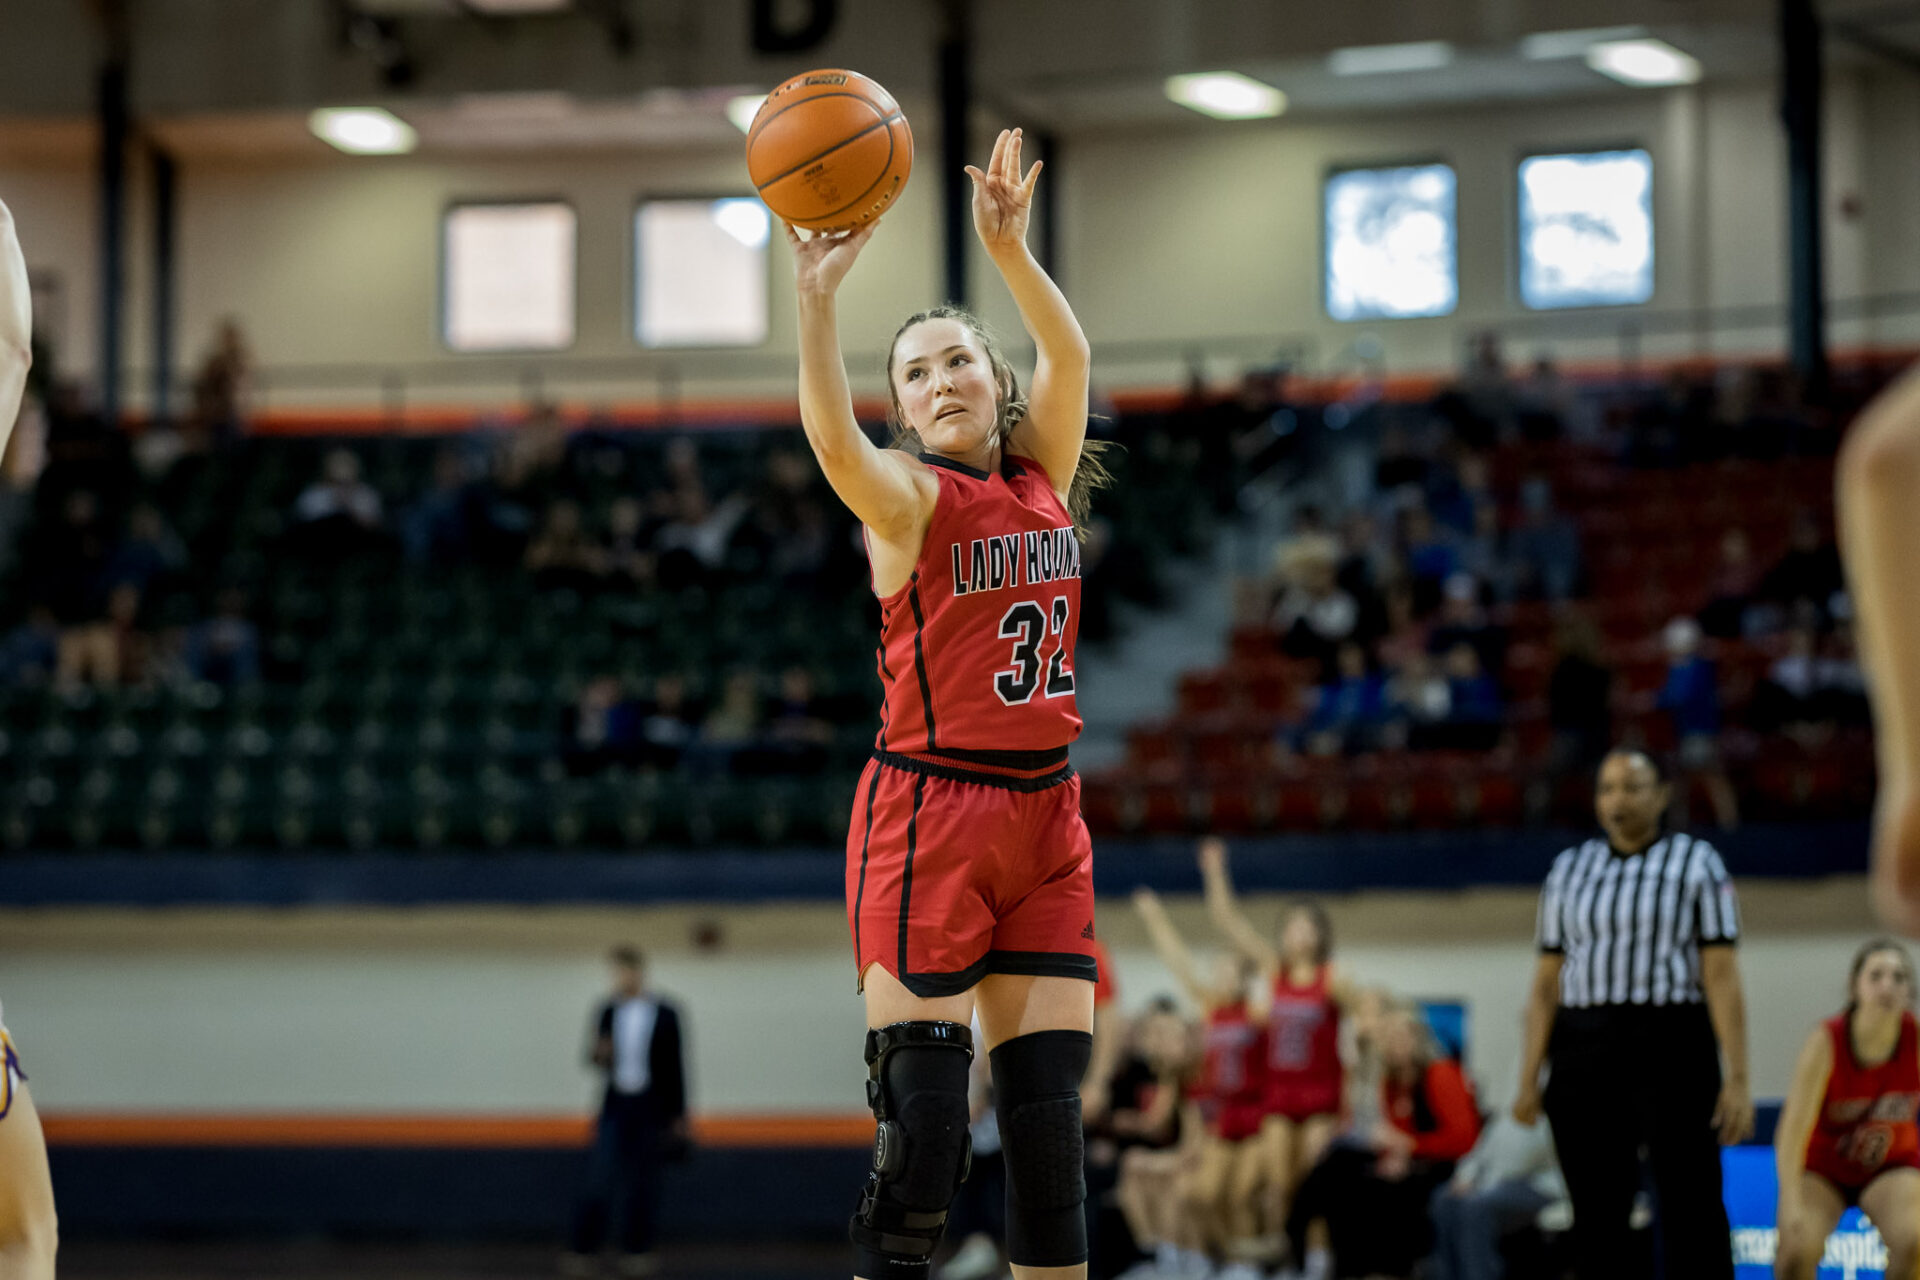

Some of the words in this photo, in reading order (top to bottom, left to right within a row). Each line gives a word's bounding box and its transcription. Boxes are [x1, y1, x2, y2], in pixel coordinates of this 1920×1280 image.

[951, 533, 1020, 597] LADY
[1024, 525, 1082, 585] HOUND
[993, 595, 1076, 707] 32
